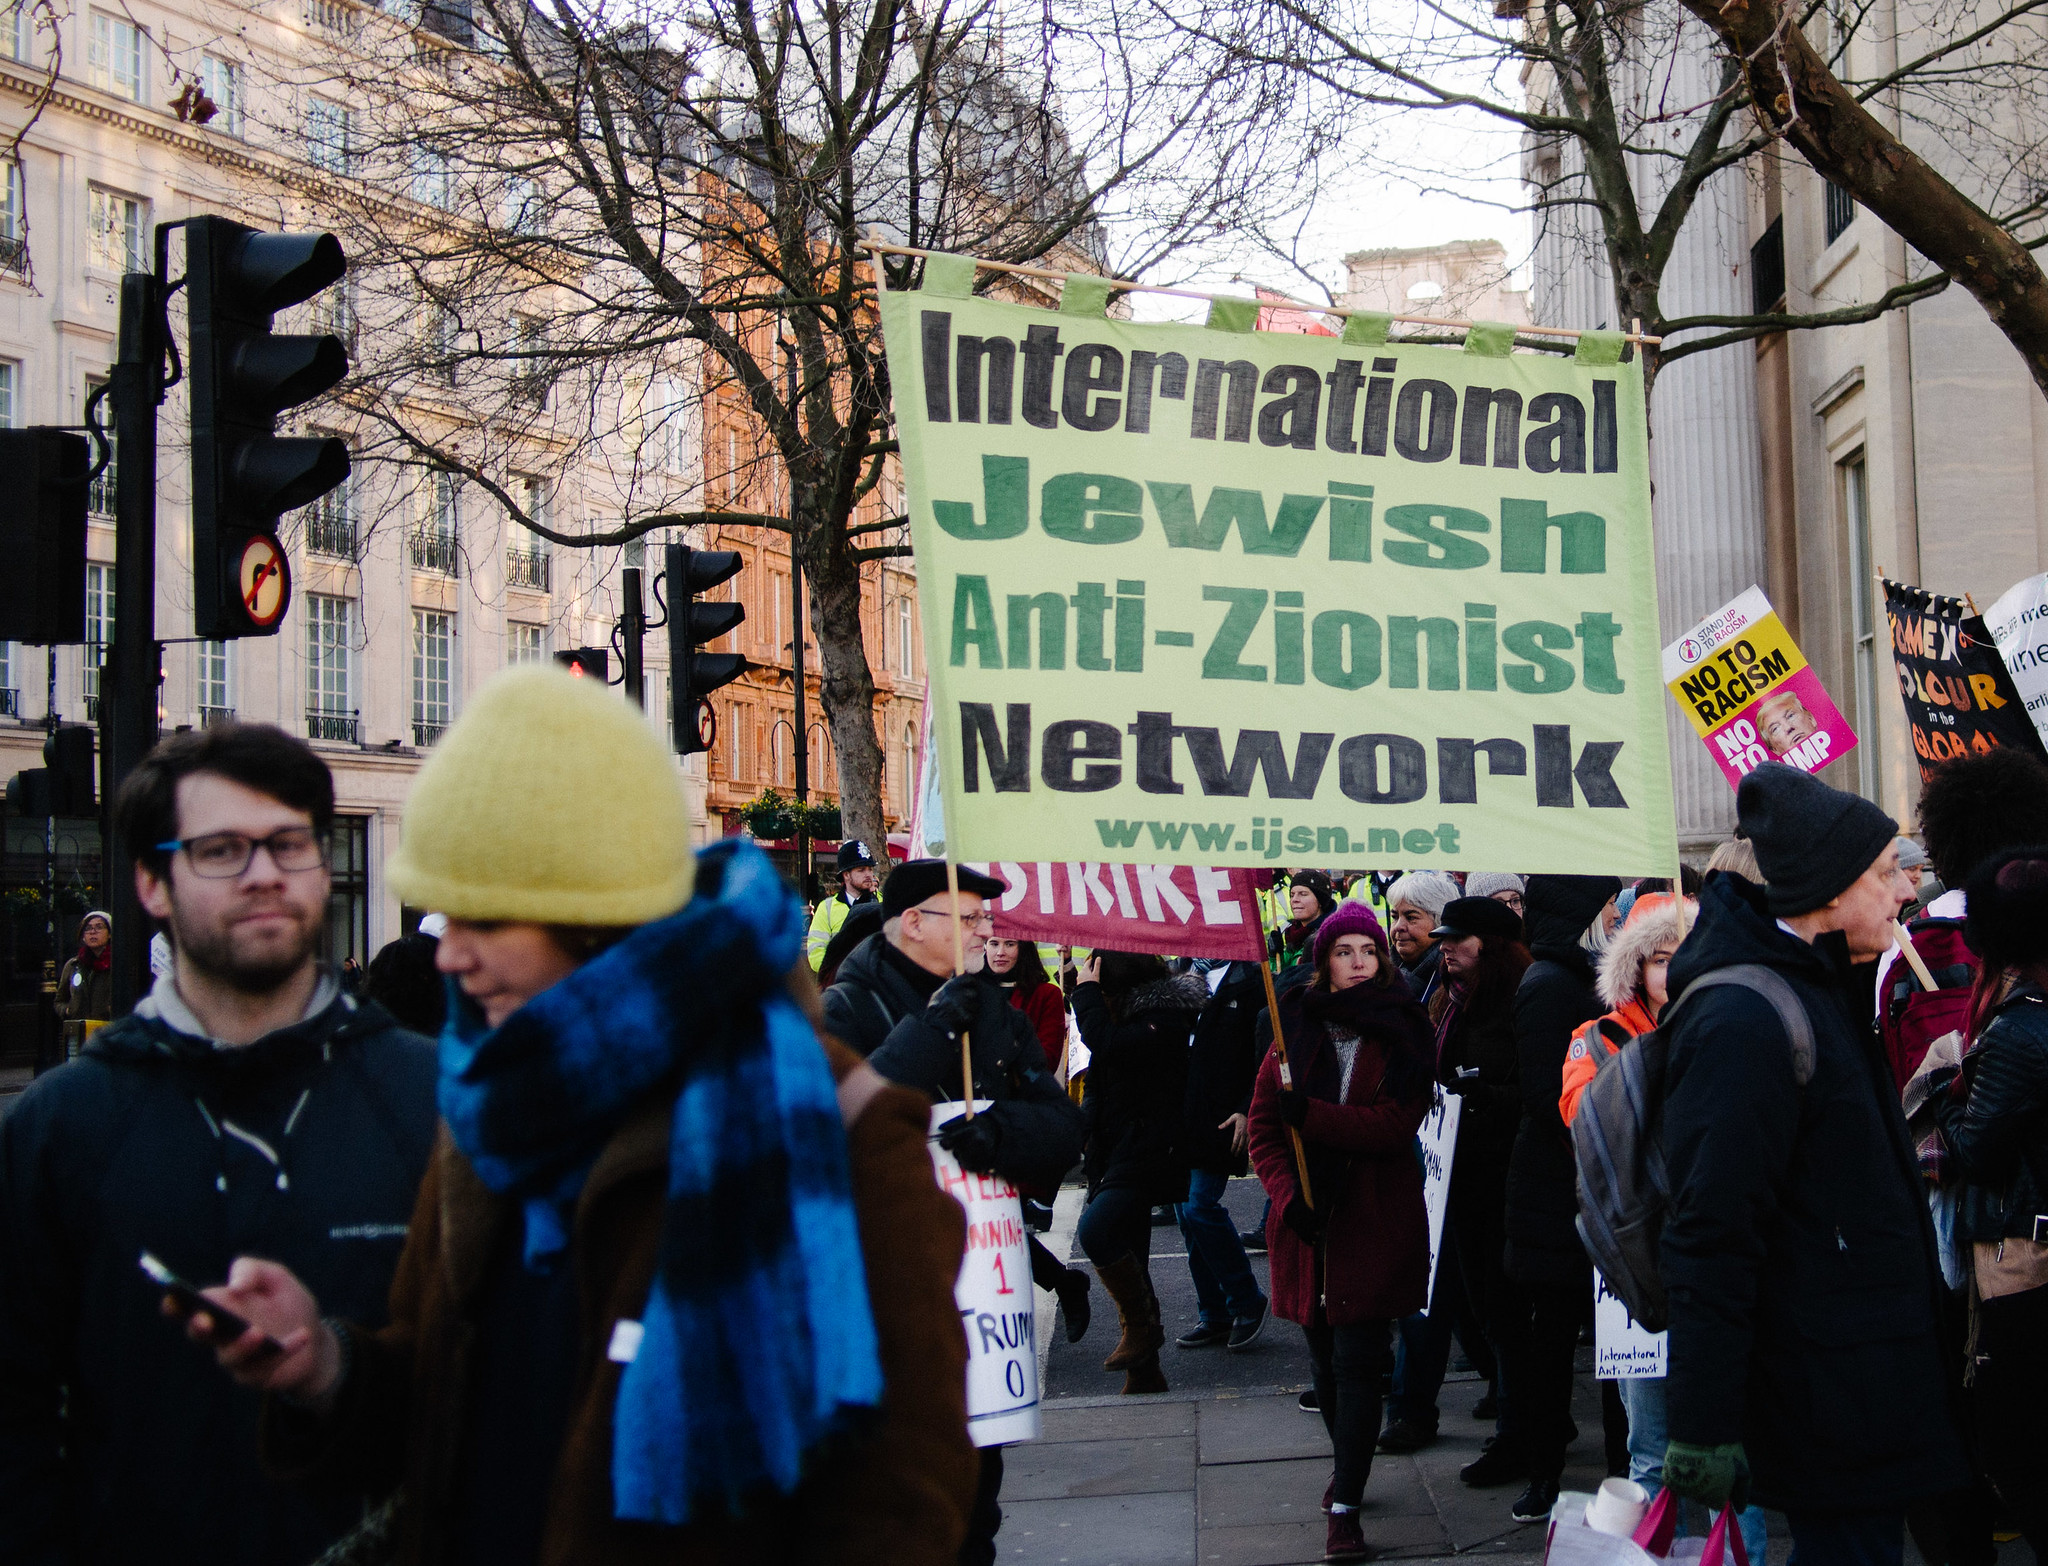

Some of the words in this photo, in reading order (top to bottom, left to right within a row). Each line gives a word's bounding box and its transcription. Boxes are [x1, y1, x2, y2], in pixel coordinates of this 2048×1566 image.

[920, 309, 1619, 475] International
[932, 453, 1608, 575] Jewish
[950, 573, 1627, 696] Anti-Zionist
[1697, 618, 1724, 642] STAND
[1723, 609, 1736, 623] UP
[1702, 637, 1715, 650] TO
[1713, 614, 1748, 642] RACISM
[1680, 665, 1721, 704] NO
[1717, 640, 1757, 675] TO
[1695, 648, 1791, 727] RACISM
[1714, 718, 1757, 759] NO
[1927, 707, 1938, 722] in
[1939, 711, 1955, 725] the
[958, 701, 1629, 810] Network
[1094, 816, 1461, 860] www.ijsn.net
[993, 1252, 1014, 1294] 1
